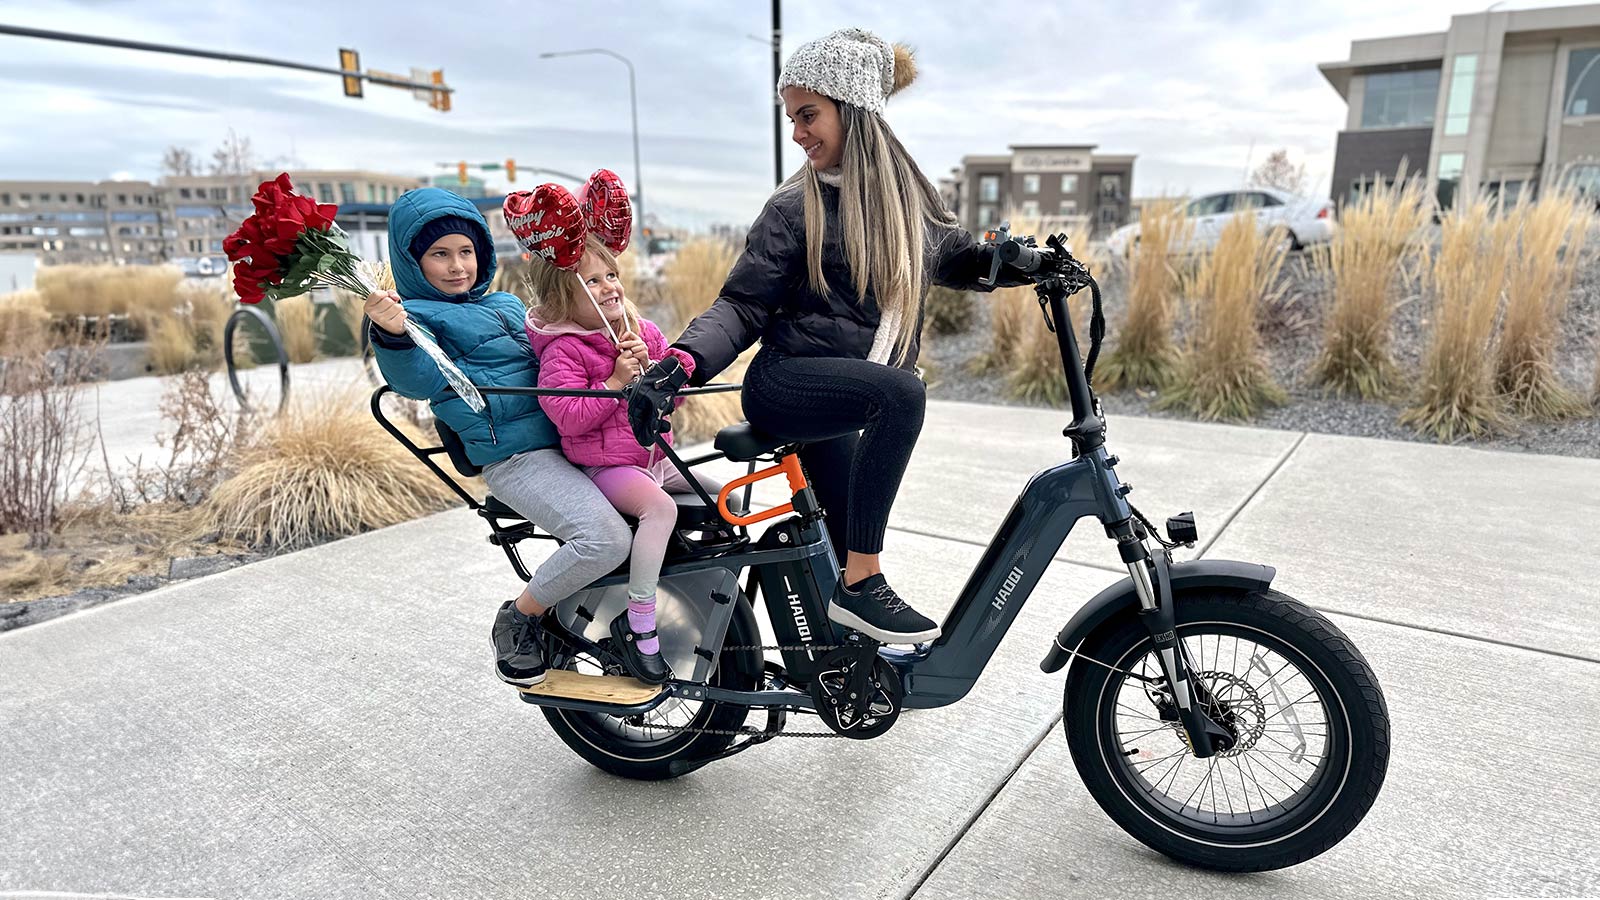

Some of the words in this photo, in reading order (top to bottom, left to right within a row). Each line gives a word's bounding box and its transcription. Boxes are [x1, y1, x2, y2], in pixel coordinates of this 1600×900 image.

[506, 209, 546, 231] Happy
[531, 246, 557, 262] Day
[991, 566, 1025, 611] HAOQI
[787, 594, 813, 642] HAOQI
